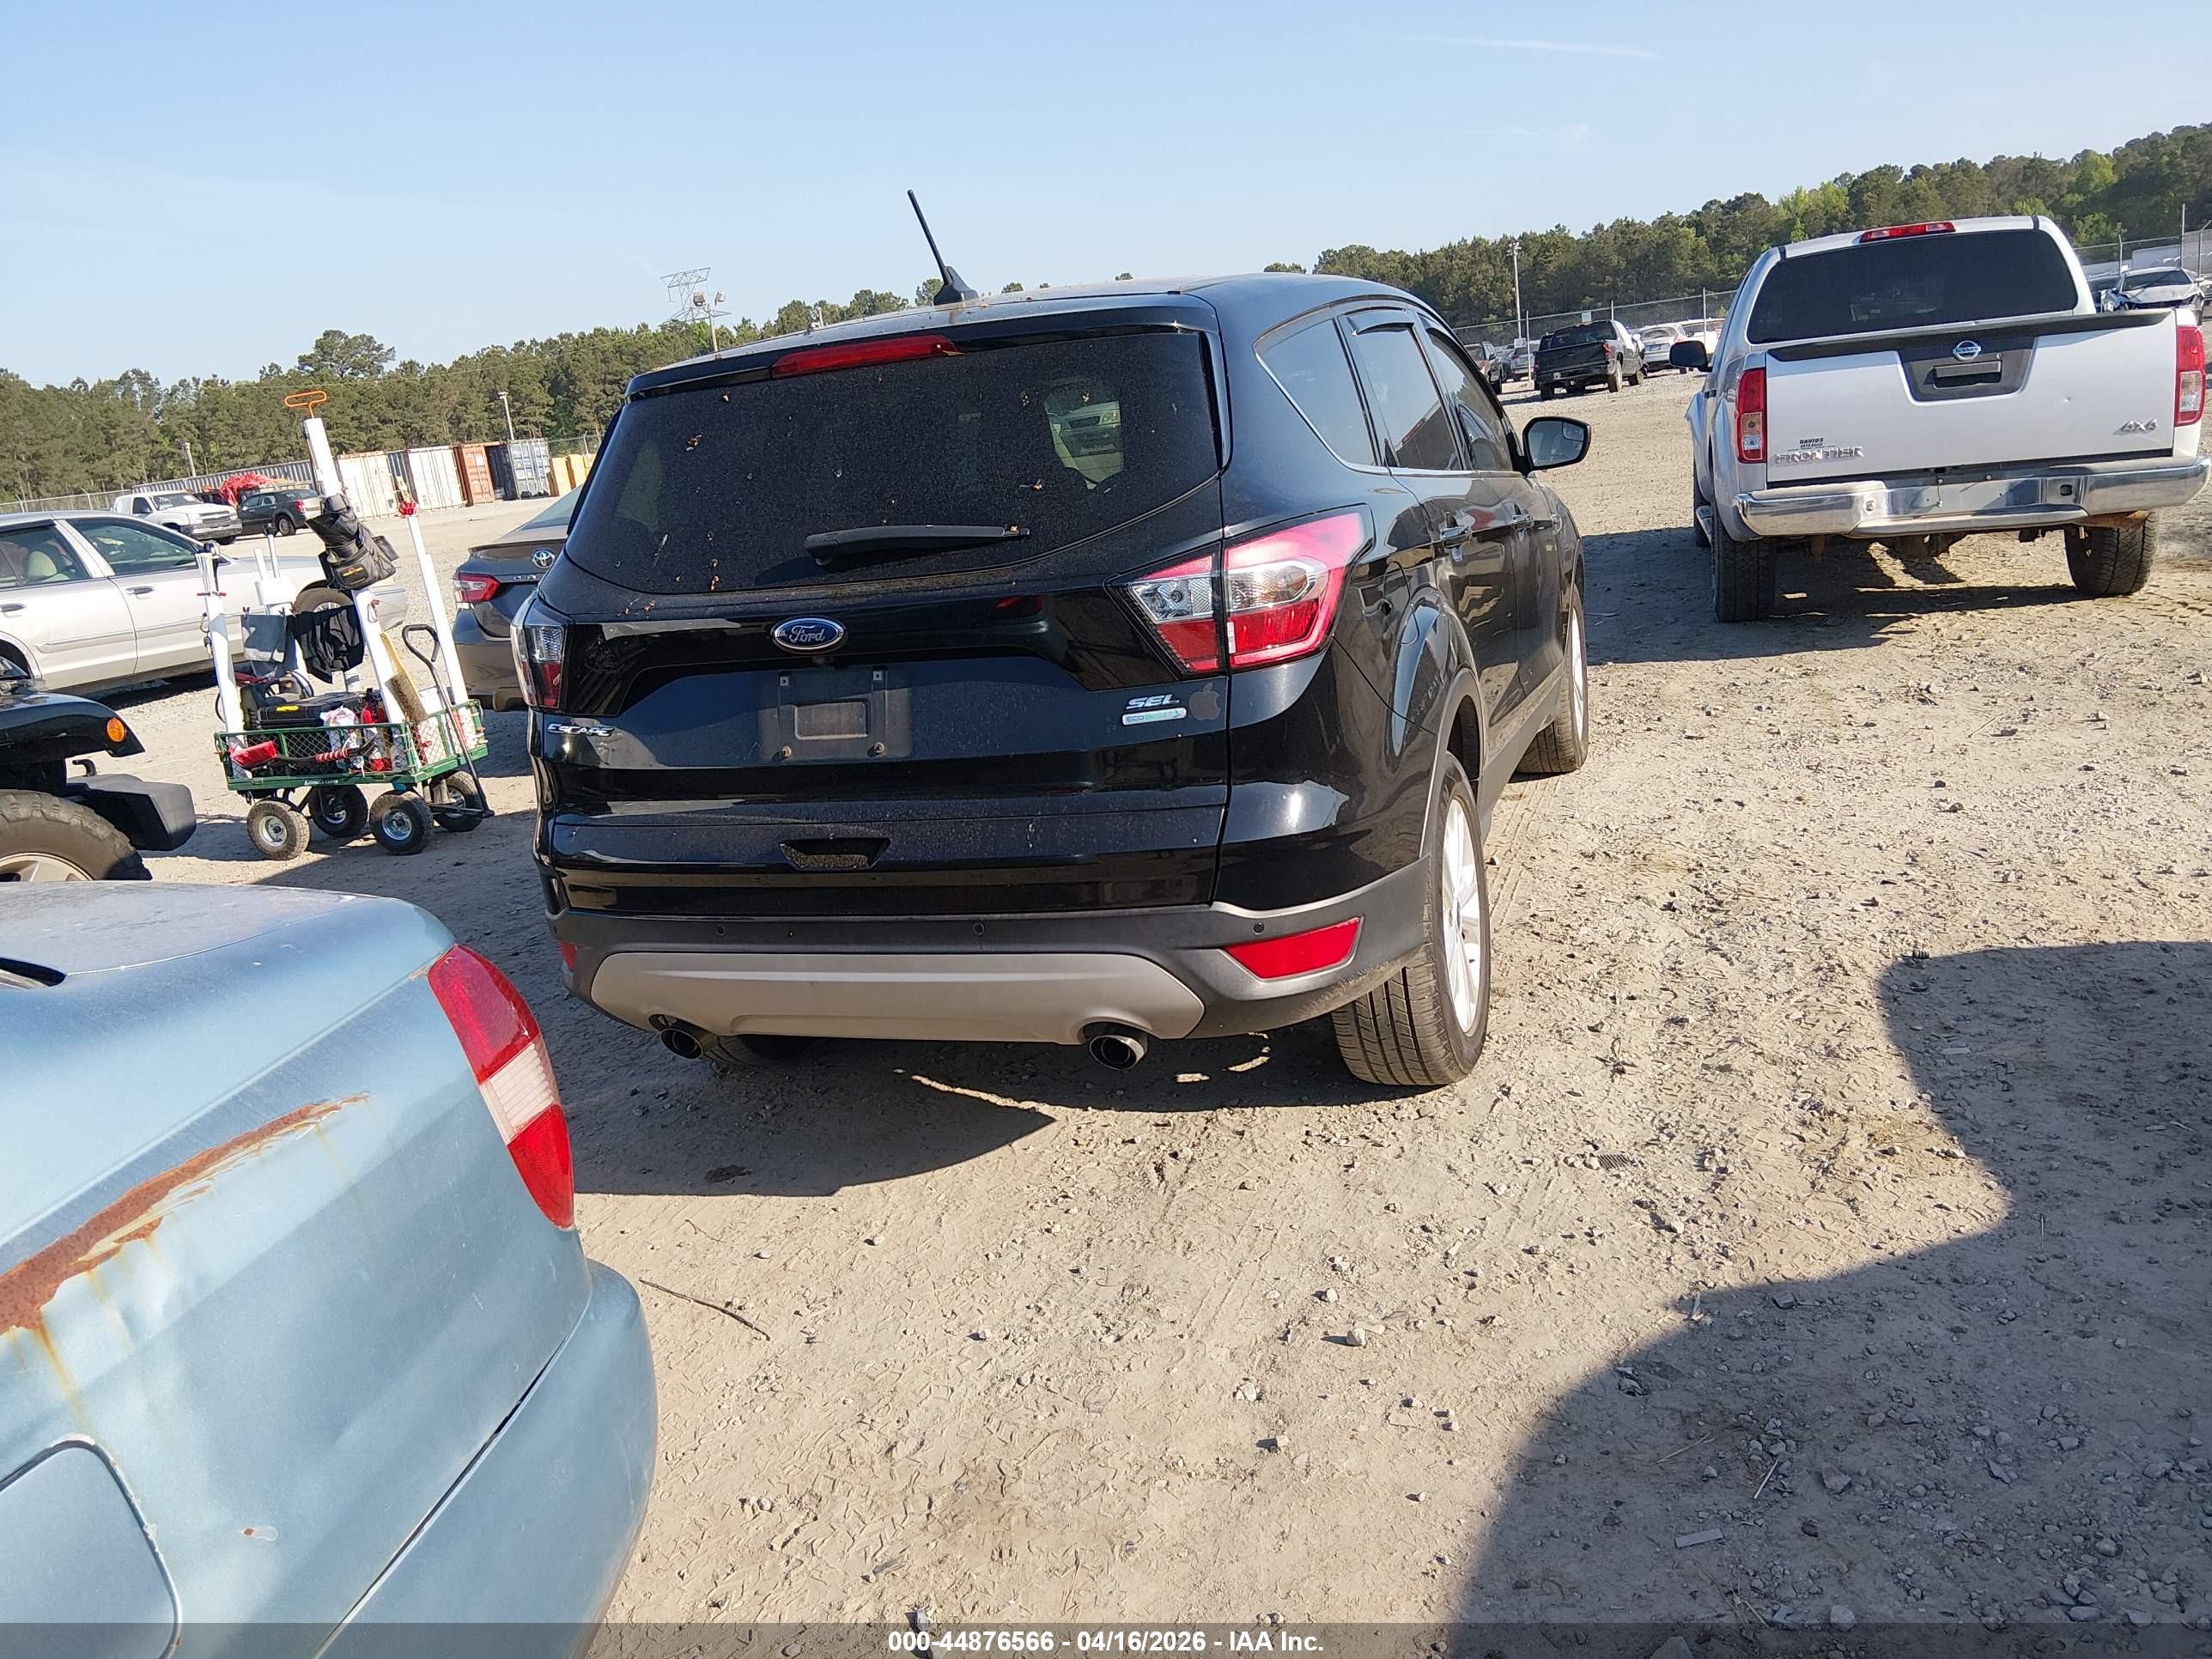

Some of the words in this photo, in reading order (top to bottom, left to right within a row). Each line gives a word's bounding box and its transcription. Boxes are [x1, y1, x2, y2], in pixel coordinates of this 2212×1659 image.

[1773, 447, 1863, 465] FRONTIER
[788, 624, 825, 643] Ford
[1126, 693, 1181, 710] SEL
[547, 723, 616, 738] ESCAPE
